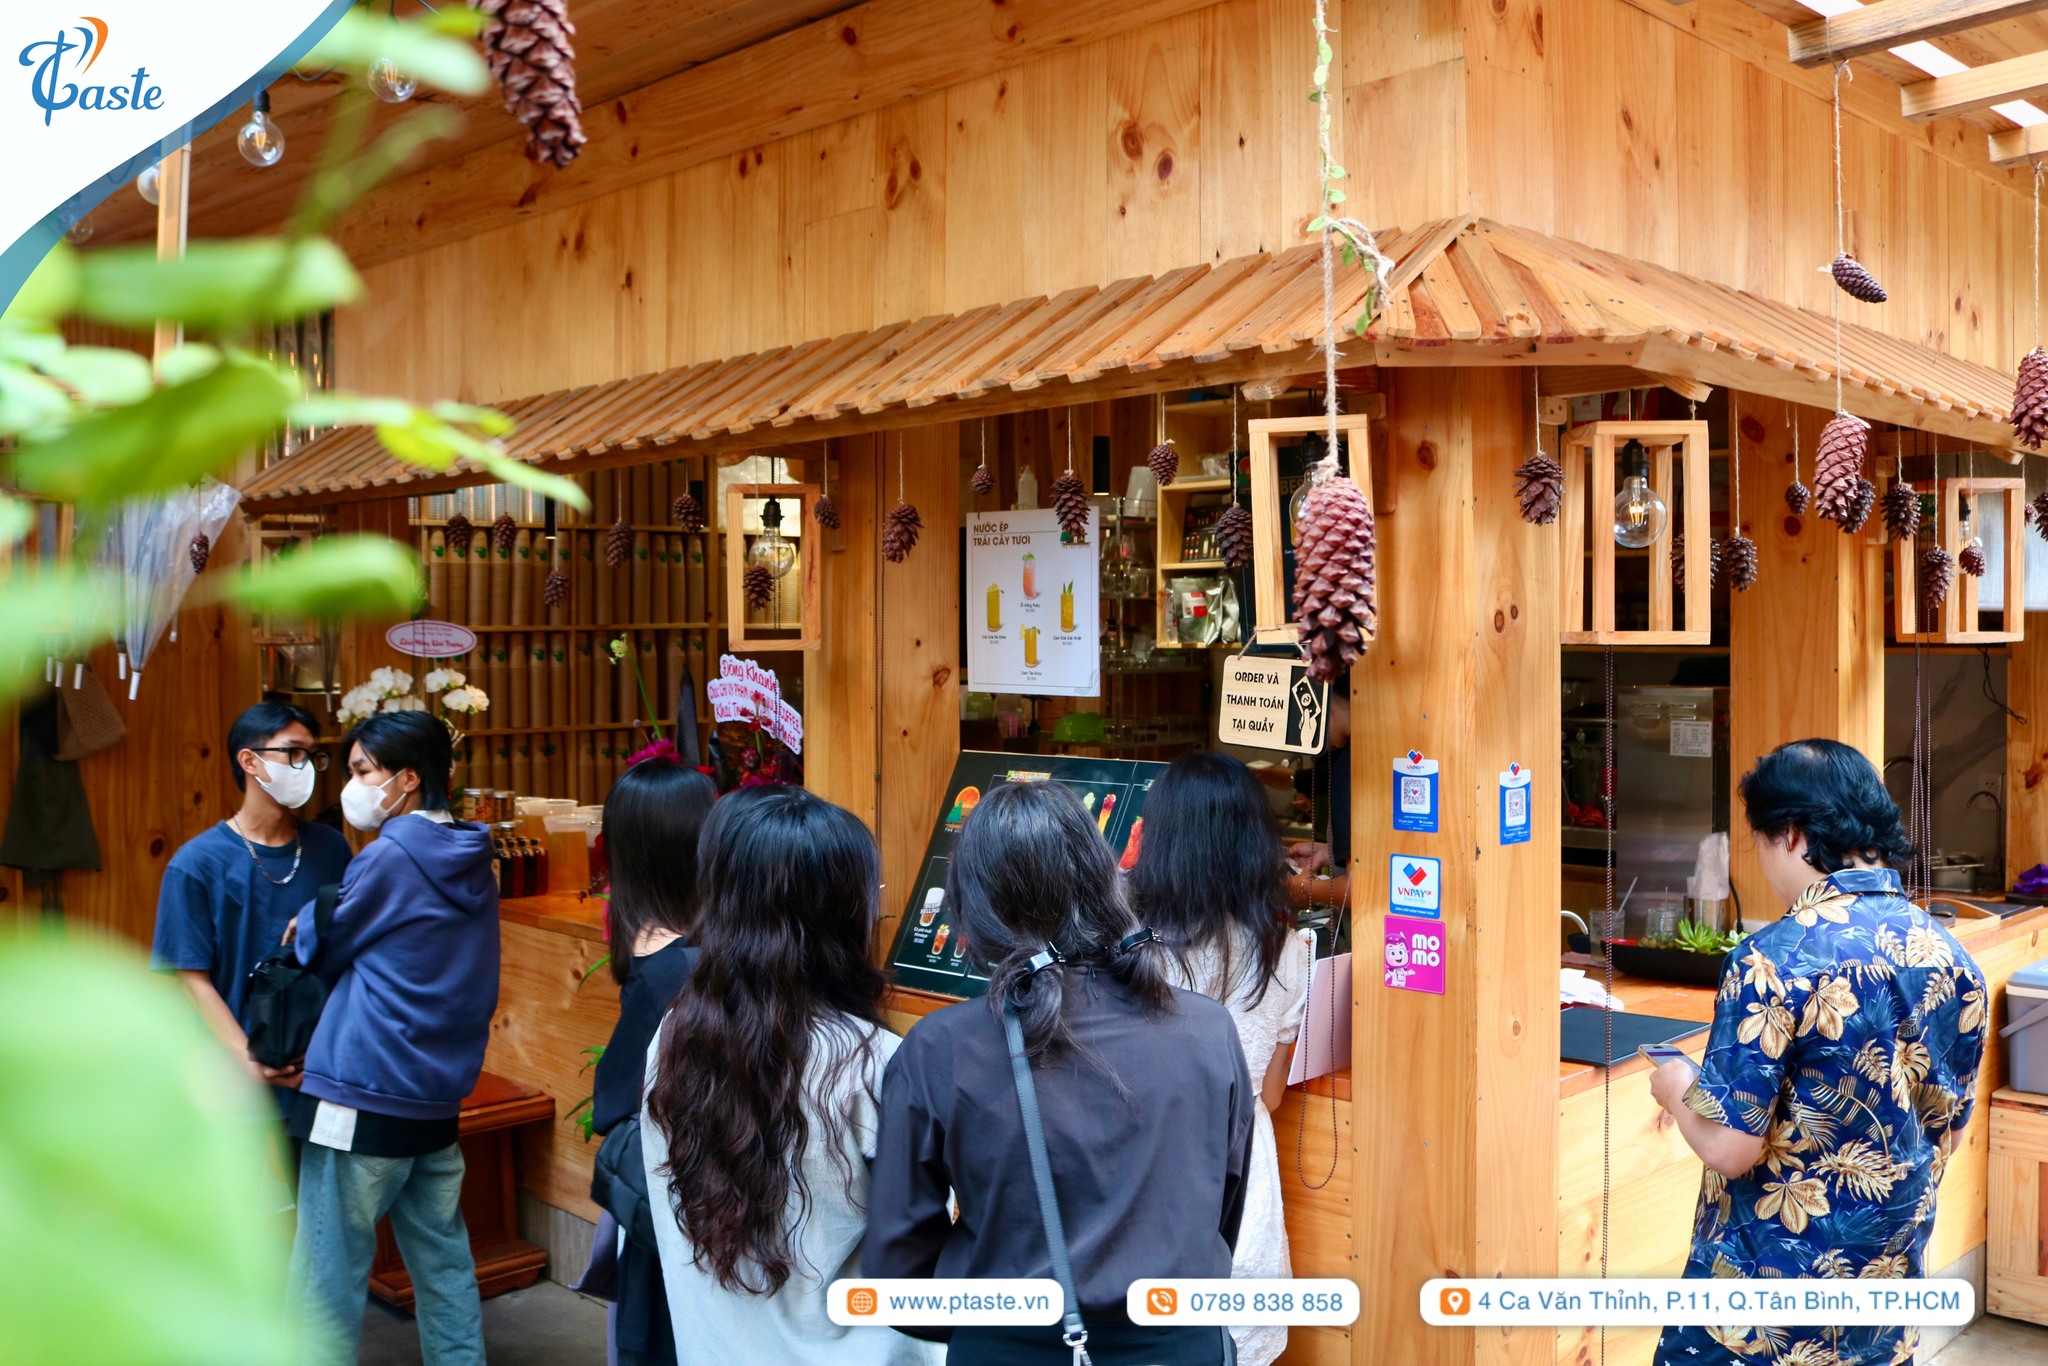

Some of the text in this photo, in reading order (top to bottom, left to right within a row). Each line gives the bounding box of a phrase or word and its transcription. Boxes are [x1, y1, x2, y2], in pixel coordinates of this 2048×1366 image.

[973, 521, 1009, 533] NƯỚC ÉP
[973, 535, 1031, 546] TRÁI CÂY TƯƠI
[1234, 671, 1280, 685] ORDER VÀ
[1226, 694, 1284, 709] THANH TOÁN
[1232, 718, 1246, 732] TẠI
